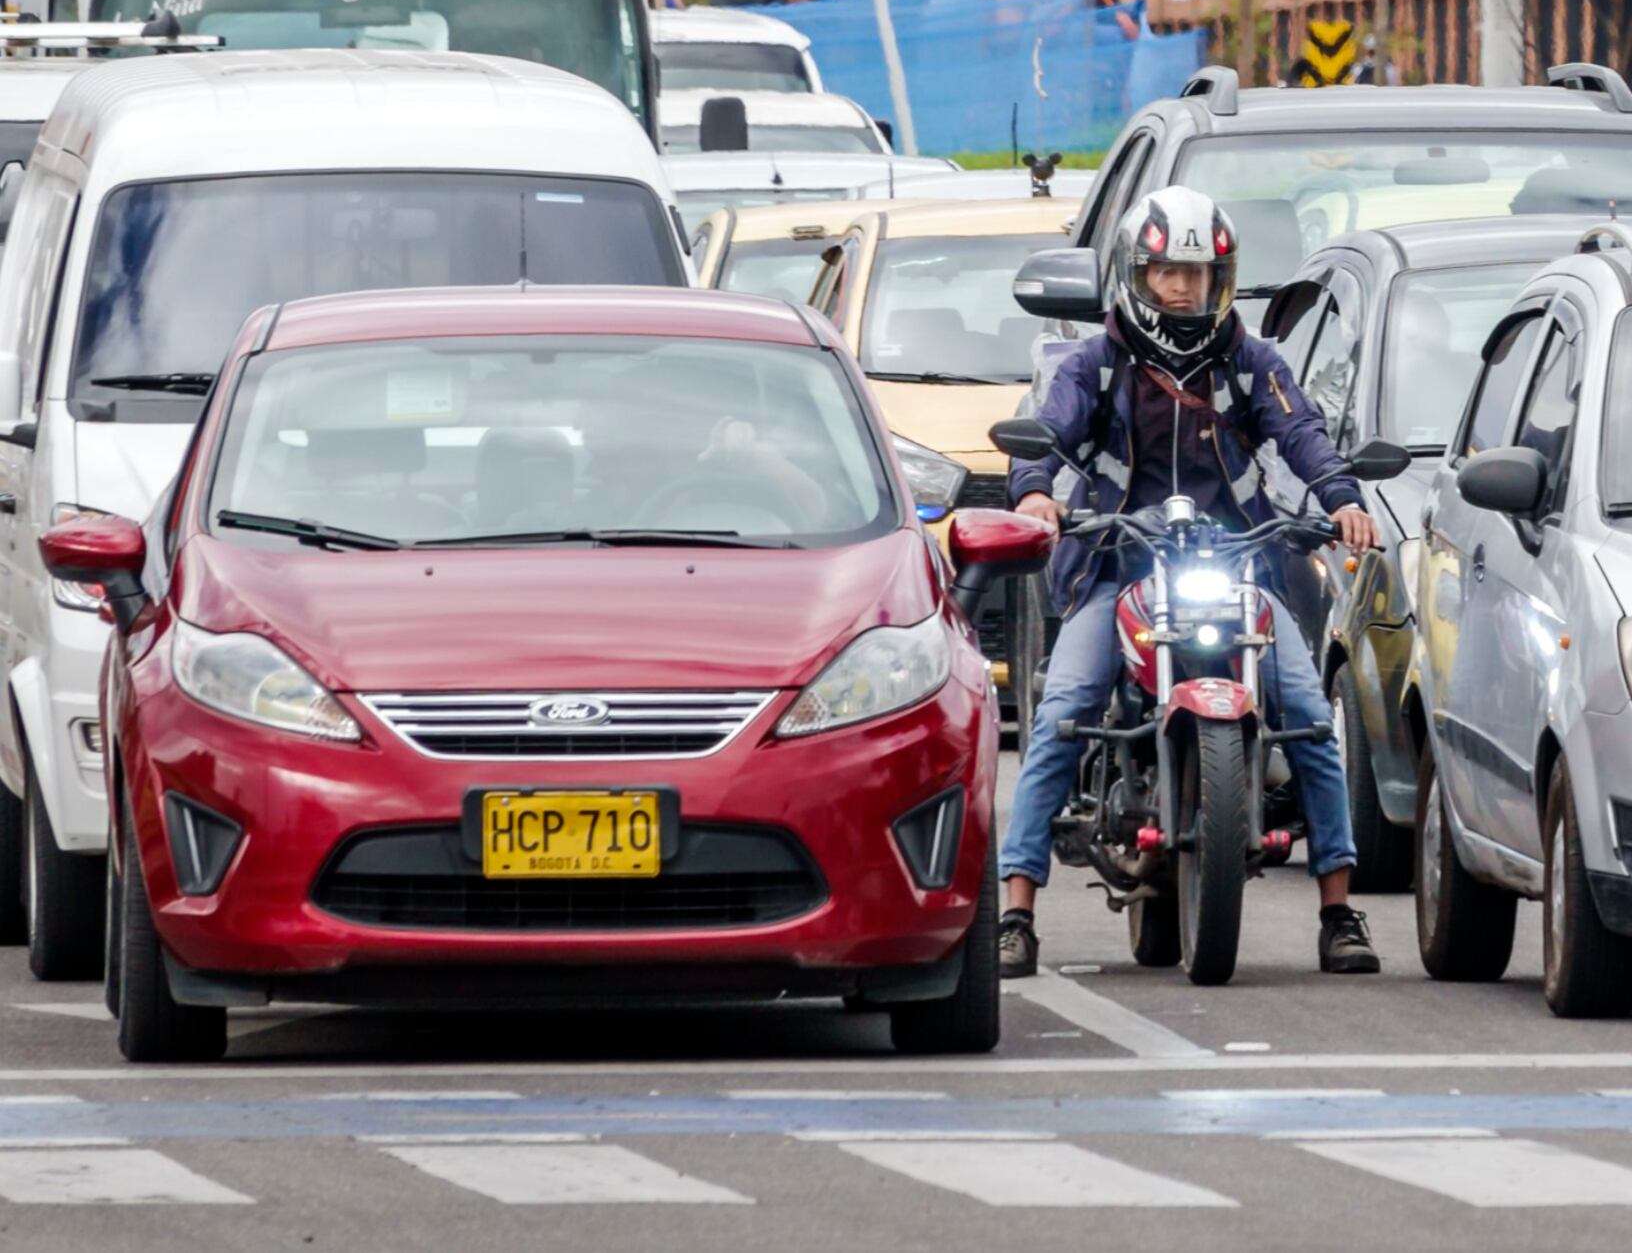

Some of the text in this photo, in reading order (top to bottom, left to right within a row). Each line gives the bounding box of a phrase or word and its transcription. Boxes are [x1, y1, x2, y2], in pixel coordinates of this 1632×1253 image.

[547, 702, 590, 720] Ford
[492, 810, 650, 852] HCP 710
[529, 857, 582, 870] BOGOTA
